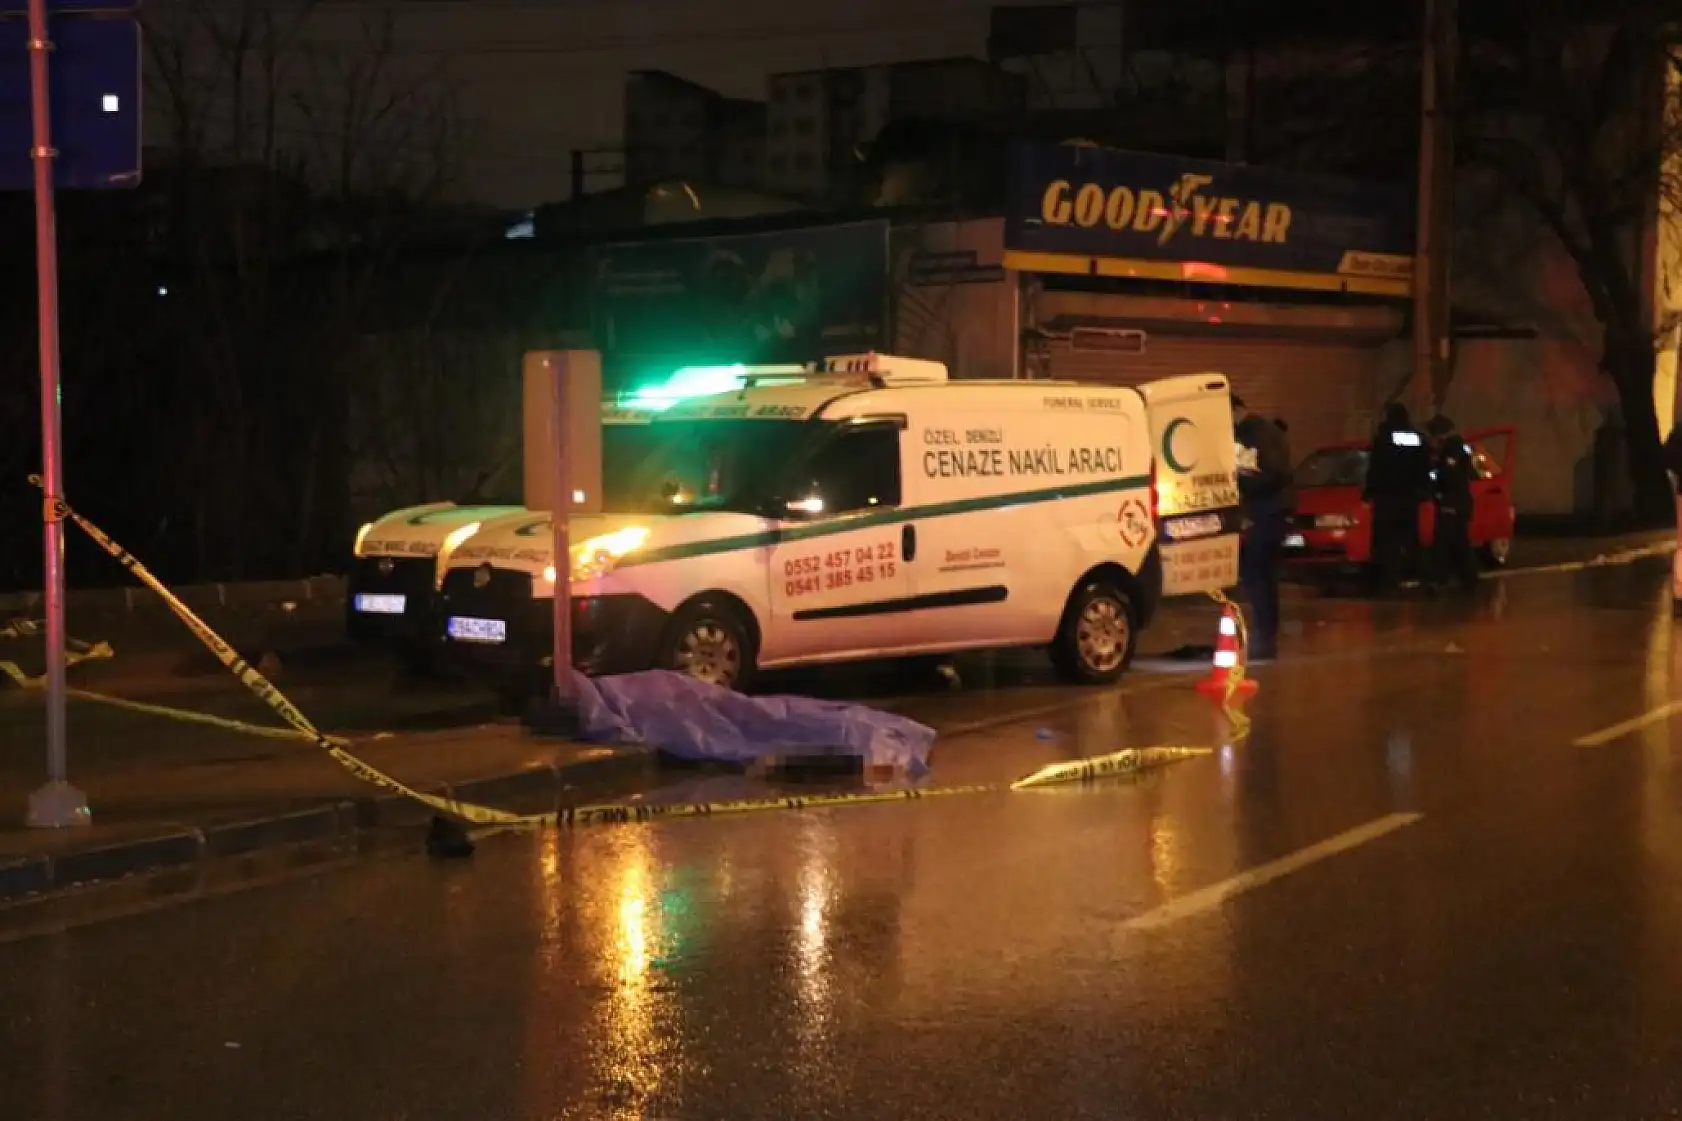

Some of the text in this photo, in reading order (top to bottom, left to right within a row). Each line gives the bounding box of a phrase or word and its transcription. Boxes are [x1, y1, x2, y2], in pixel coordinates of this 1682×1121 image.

[1042, 174, 1292, 246] GOODYEAR
[923, 426, 961, 446] ÖZEL
[922, 443, 1123, 479] CENAZE NAKİL ARACI
[784, 542, 895, 578] 0552 457 04 22
[785, 577, 821, 597] 0541
[856, 565, 874, 583] 45
[878, 562, 895, 579] 15
